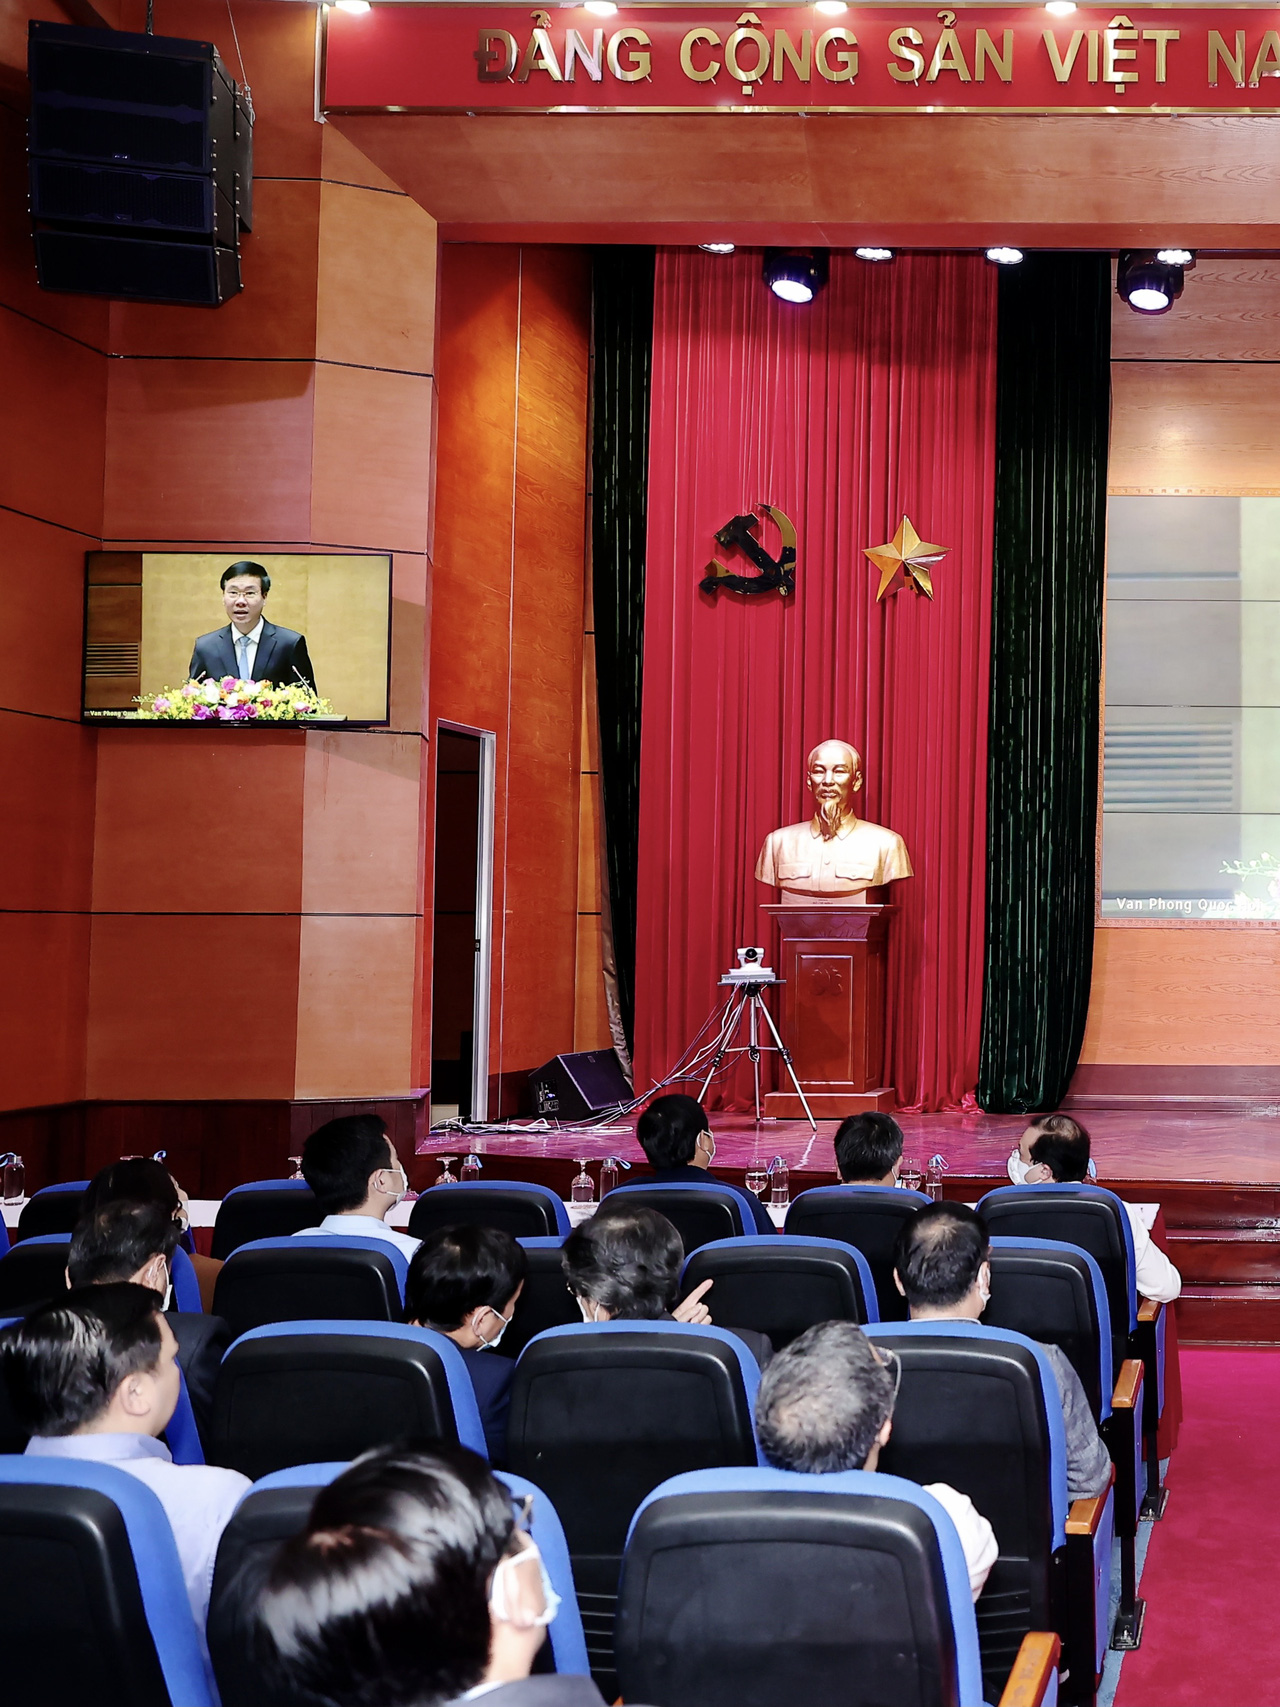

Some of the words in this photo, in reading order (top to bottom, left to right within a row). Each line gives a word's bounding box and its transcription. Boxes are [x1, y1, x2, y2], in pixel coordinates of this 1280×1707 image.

[474, 10, 652, 83] ĐẢNG
[679, 12, 859, 96] CỘNG
[886, 10, 1013, 84] SẢN
[1042, 15, 1180, 94] VIỆT
[1116, 897, 1143, 910] Van
[1149, 897, 1192, 914] Phong
[1198, 898, 1234, 911] Quoc
